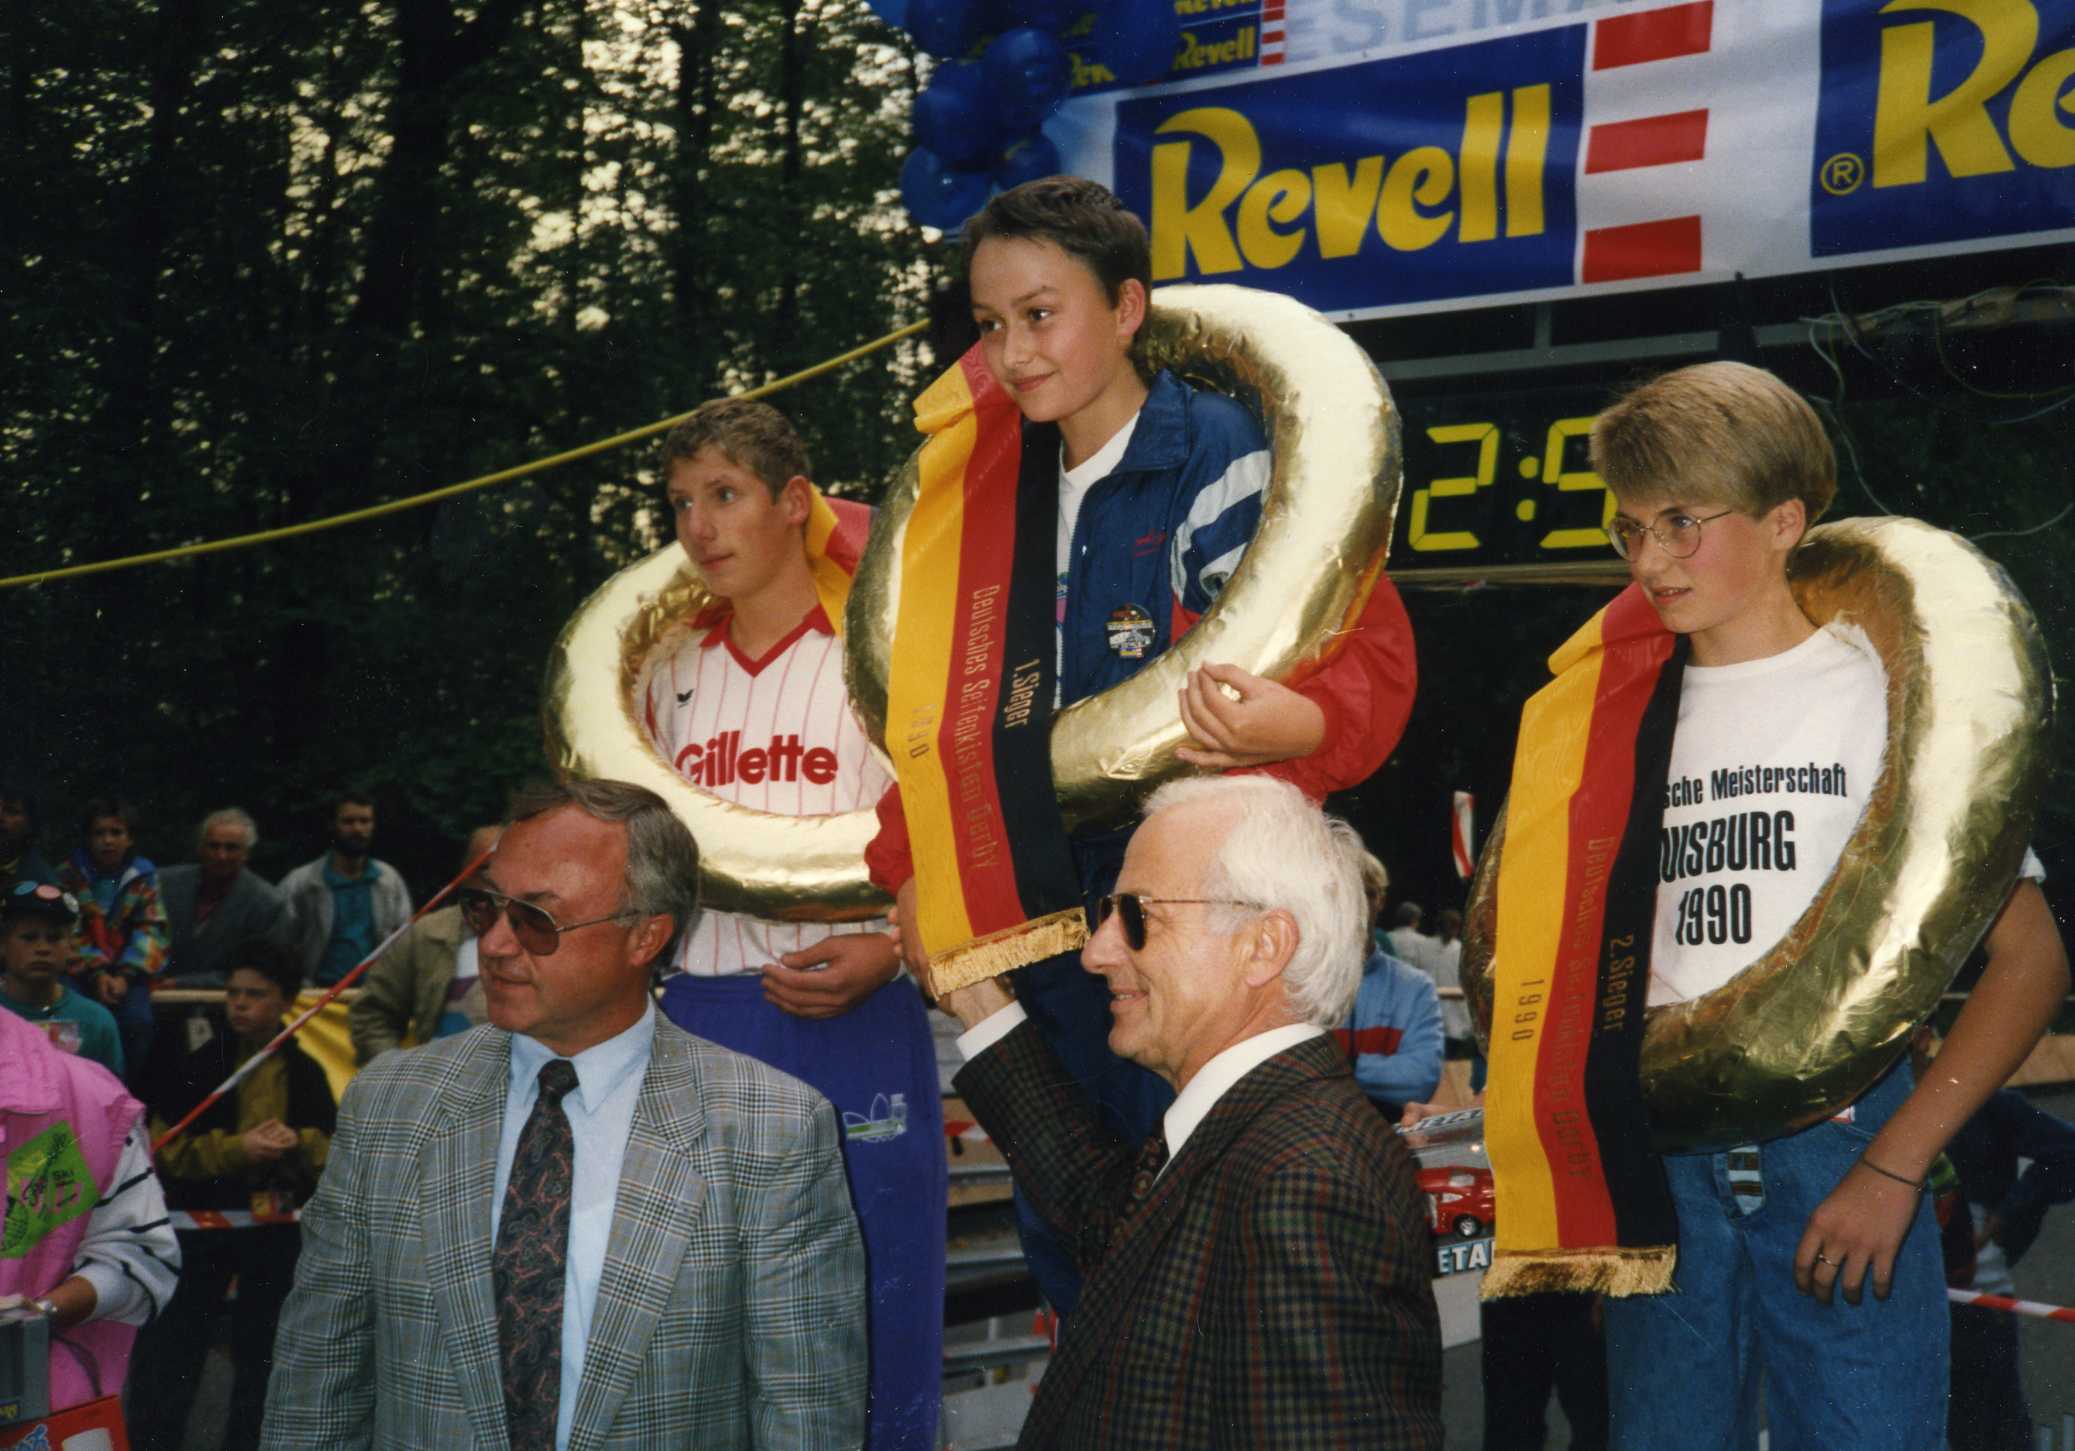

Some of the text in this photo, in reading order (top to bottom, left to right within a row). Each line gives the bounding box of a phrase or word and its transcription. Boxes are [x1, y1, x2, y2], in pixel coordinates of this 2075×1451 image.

[1173, 27, 1255, 70] Revell
[1151, 83, 1551, 282] Revell
[963, 584, 1001, 676] Deutsches
[675, 730, 839, 787] Gillette
[1711, 762, 1848, 801] Meisterschaft
[1659, 810, 1797, 883] UISBURG
[1675, 883, 1753, 946] 1990
[1512, 978, 1545, 1041] 1990
[1437, 1240, 1496, 1275] ETA
